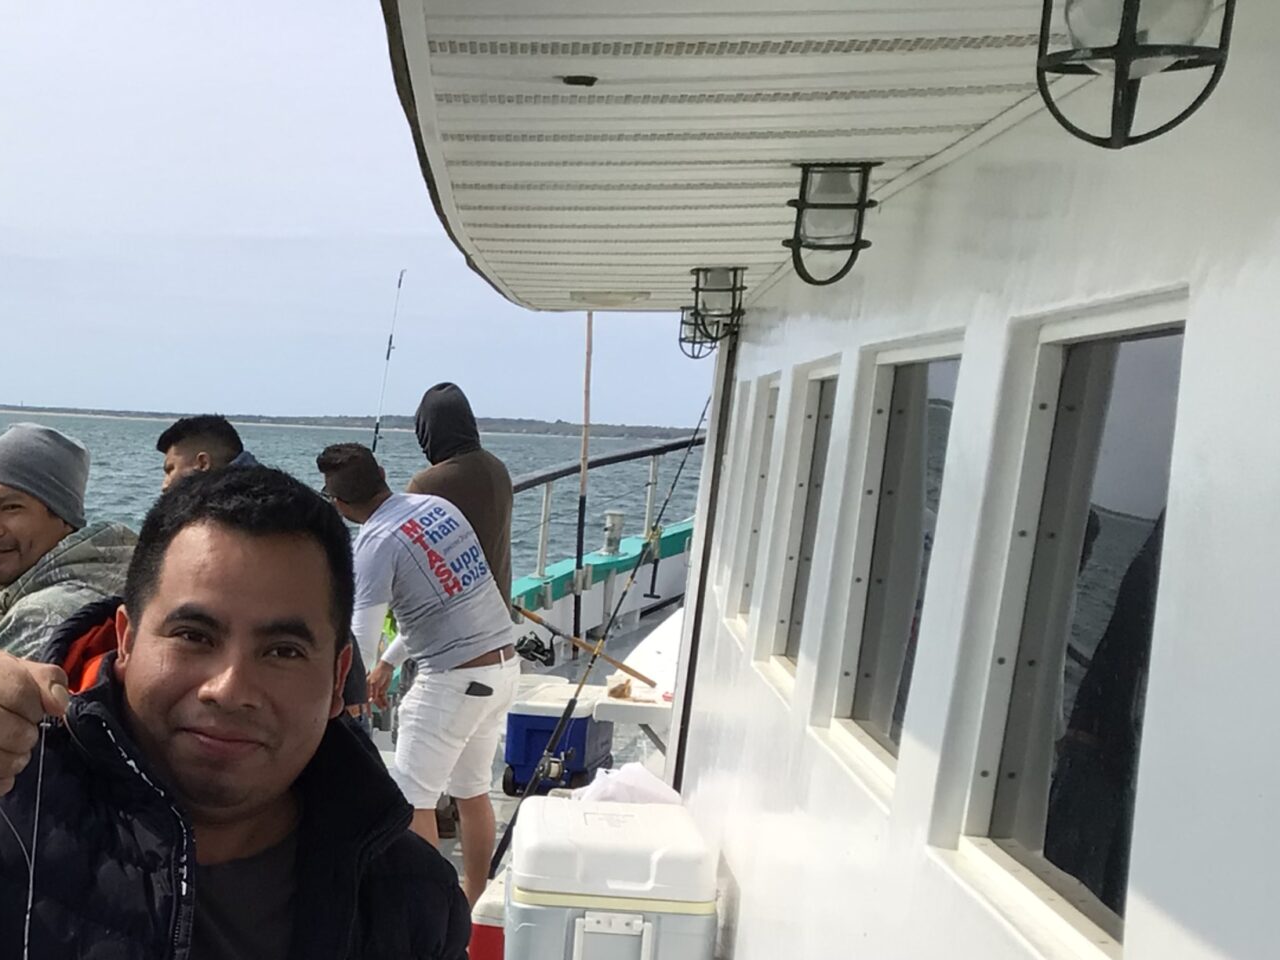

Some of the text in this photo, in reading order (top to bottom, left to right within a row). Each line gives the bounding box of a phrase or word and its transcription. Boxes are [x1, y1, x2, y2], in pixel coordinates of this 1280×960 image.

[400, 506, 447, 539] More
[412, 515, 460, 551] Than
[434, 541, 482, 583] Supp
